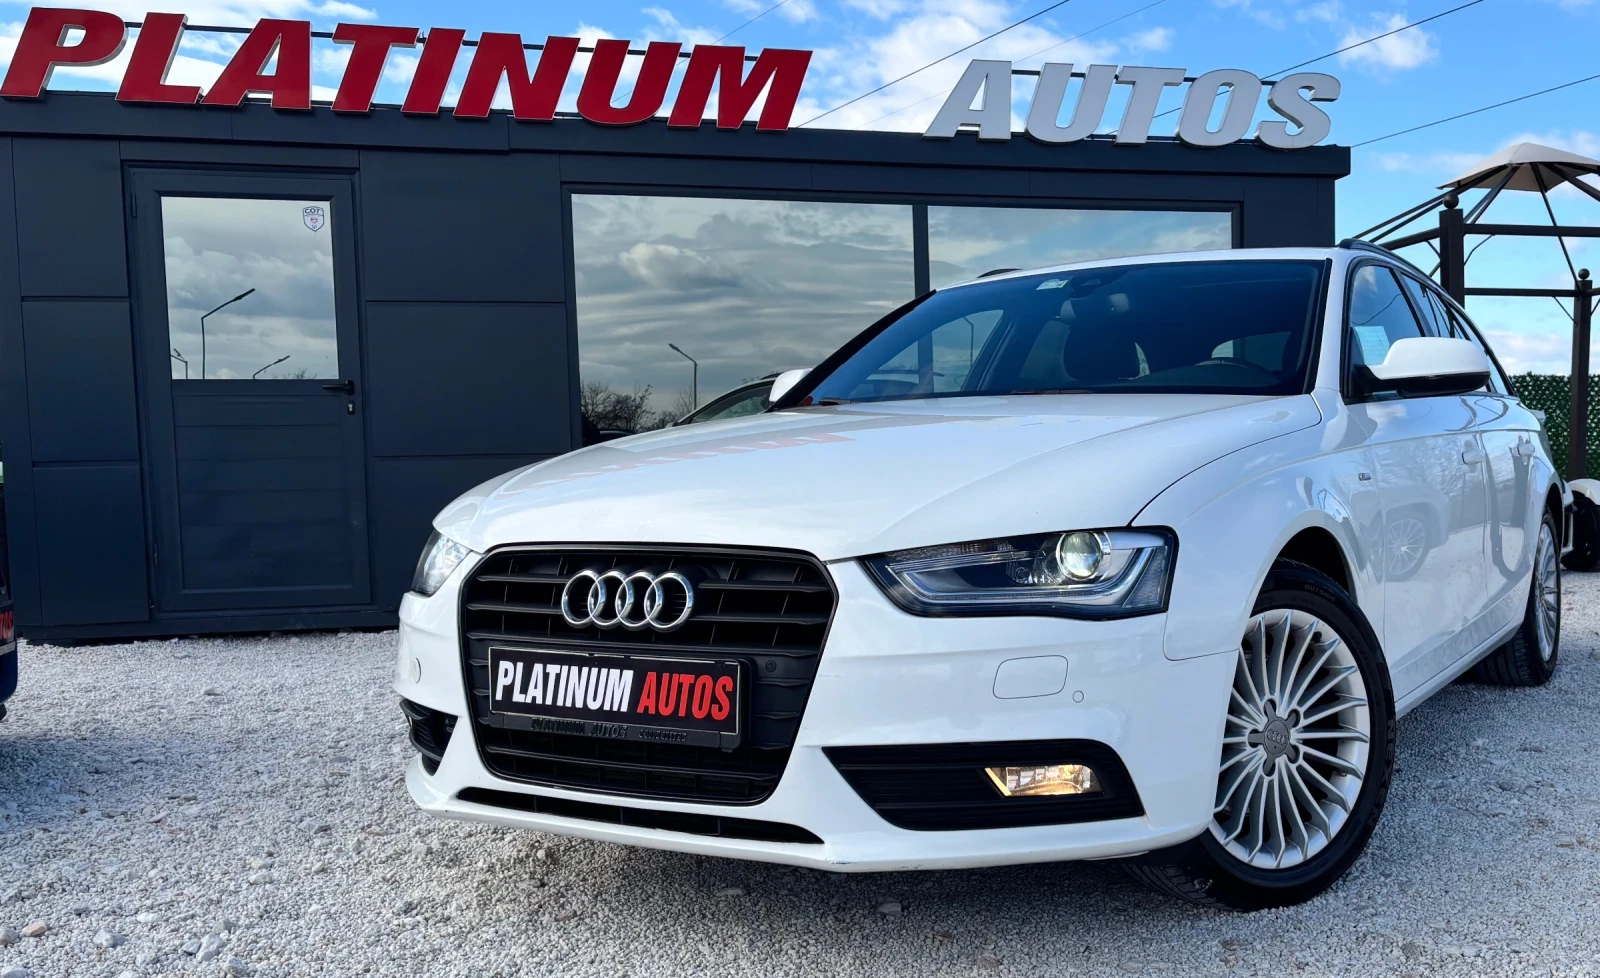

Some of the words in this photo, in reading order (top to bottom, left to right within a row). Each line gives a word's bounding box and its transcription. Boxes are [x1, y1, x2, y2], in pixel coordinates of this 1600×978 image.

[0, 7, 813, 131] PLATINUM
[922, 59, 1341, 150] AUTOS
[495, 660, 634, 712] PLATINUM
[637, 672, 733, 720] AUTOS
[589, 722, 628, 738] AUTOS
[1367, 719, 1395, 826] NEXEN
